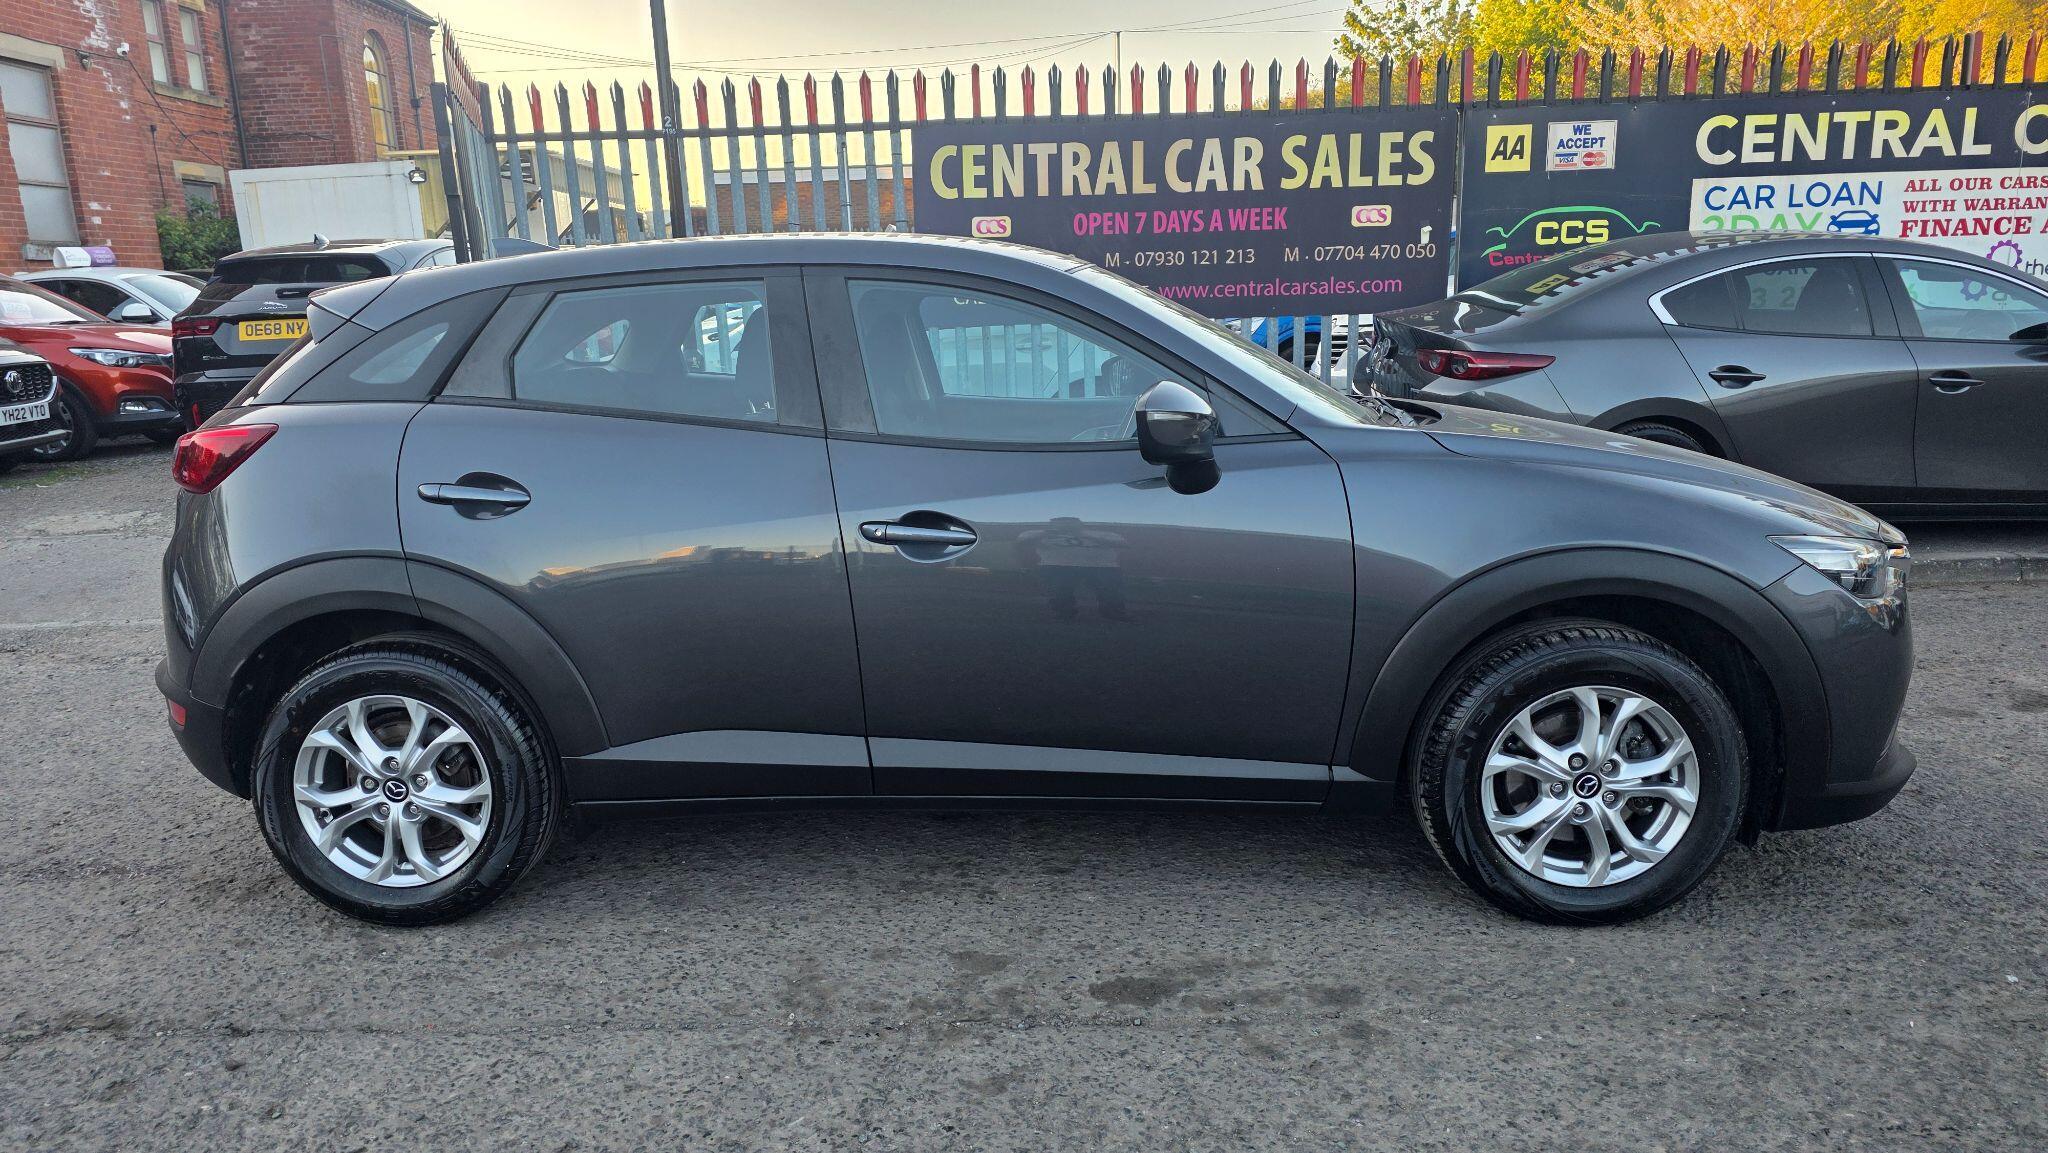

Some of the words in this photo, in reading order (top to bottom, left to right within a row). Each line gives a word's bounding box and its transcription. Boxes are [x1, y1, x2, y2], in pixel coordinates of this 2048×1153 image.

[664, 115, 672, 127] 2
[1572, 124, 1592, 136] WE
[1556, 137, 1606, 150] ACCEPT
[1696, 106, 1993, 166] CENTRAL
[1490, 134, 1526, 161] AA
[930, 139, 1157, 200] CENTRAL
[1164, 136, 1264, 194] CAR
[1280, 130, 1435, 190] SALES
[1904, 178, 1942, 193] ALL
[1949, 177, 1993, 191] OUR
[2000, 175, 2048, 190] CARS
[1704, 184, 1776, 212] CAR
[1788, 180, 1884, 208] LOAN
[1902, 199, 1957, 213] WITH
[1073, 211, 1129, 237] OPEN
[1135, 211, 1147, 235] 7
[1153, 209, 1204, 235] DAYS
[1208, 208, 1224, 232] A
[1228, 206, 1289, 232] WEEK
[1535, 218, 1610, 246] CCS
[1899, 216, 2033, 238] FINANCE
[1134, 251, 1185, 267] 07930
[1191, 250, 1218, 265] 121
[1225, 248, 1256, 265] 213
[1314, 245, 1365, 262] 07704
[1370, 244, 1400, 261] 470
[1405, 243, 1436, 259] 050
[1158, 276, 1402, 299] www.centralcarsales.com
[245, 322, 282, 337] OE68
[2, 407, 28, 422] YH22
[29, 403, 46, 418] VTO
